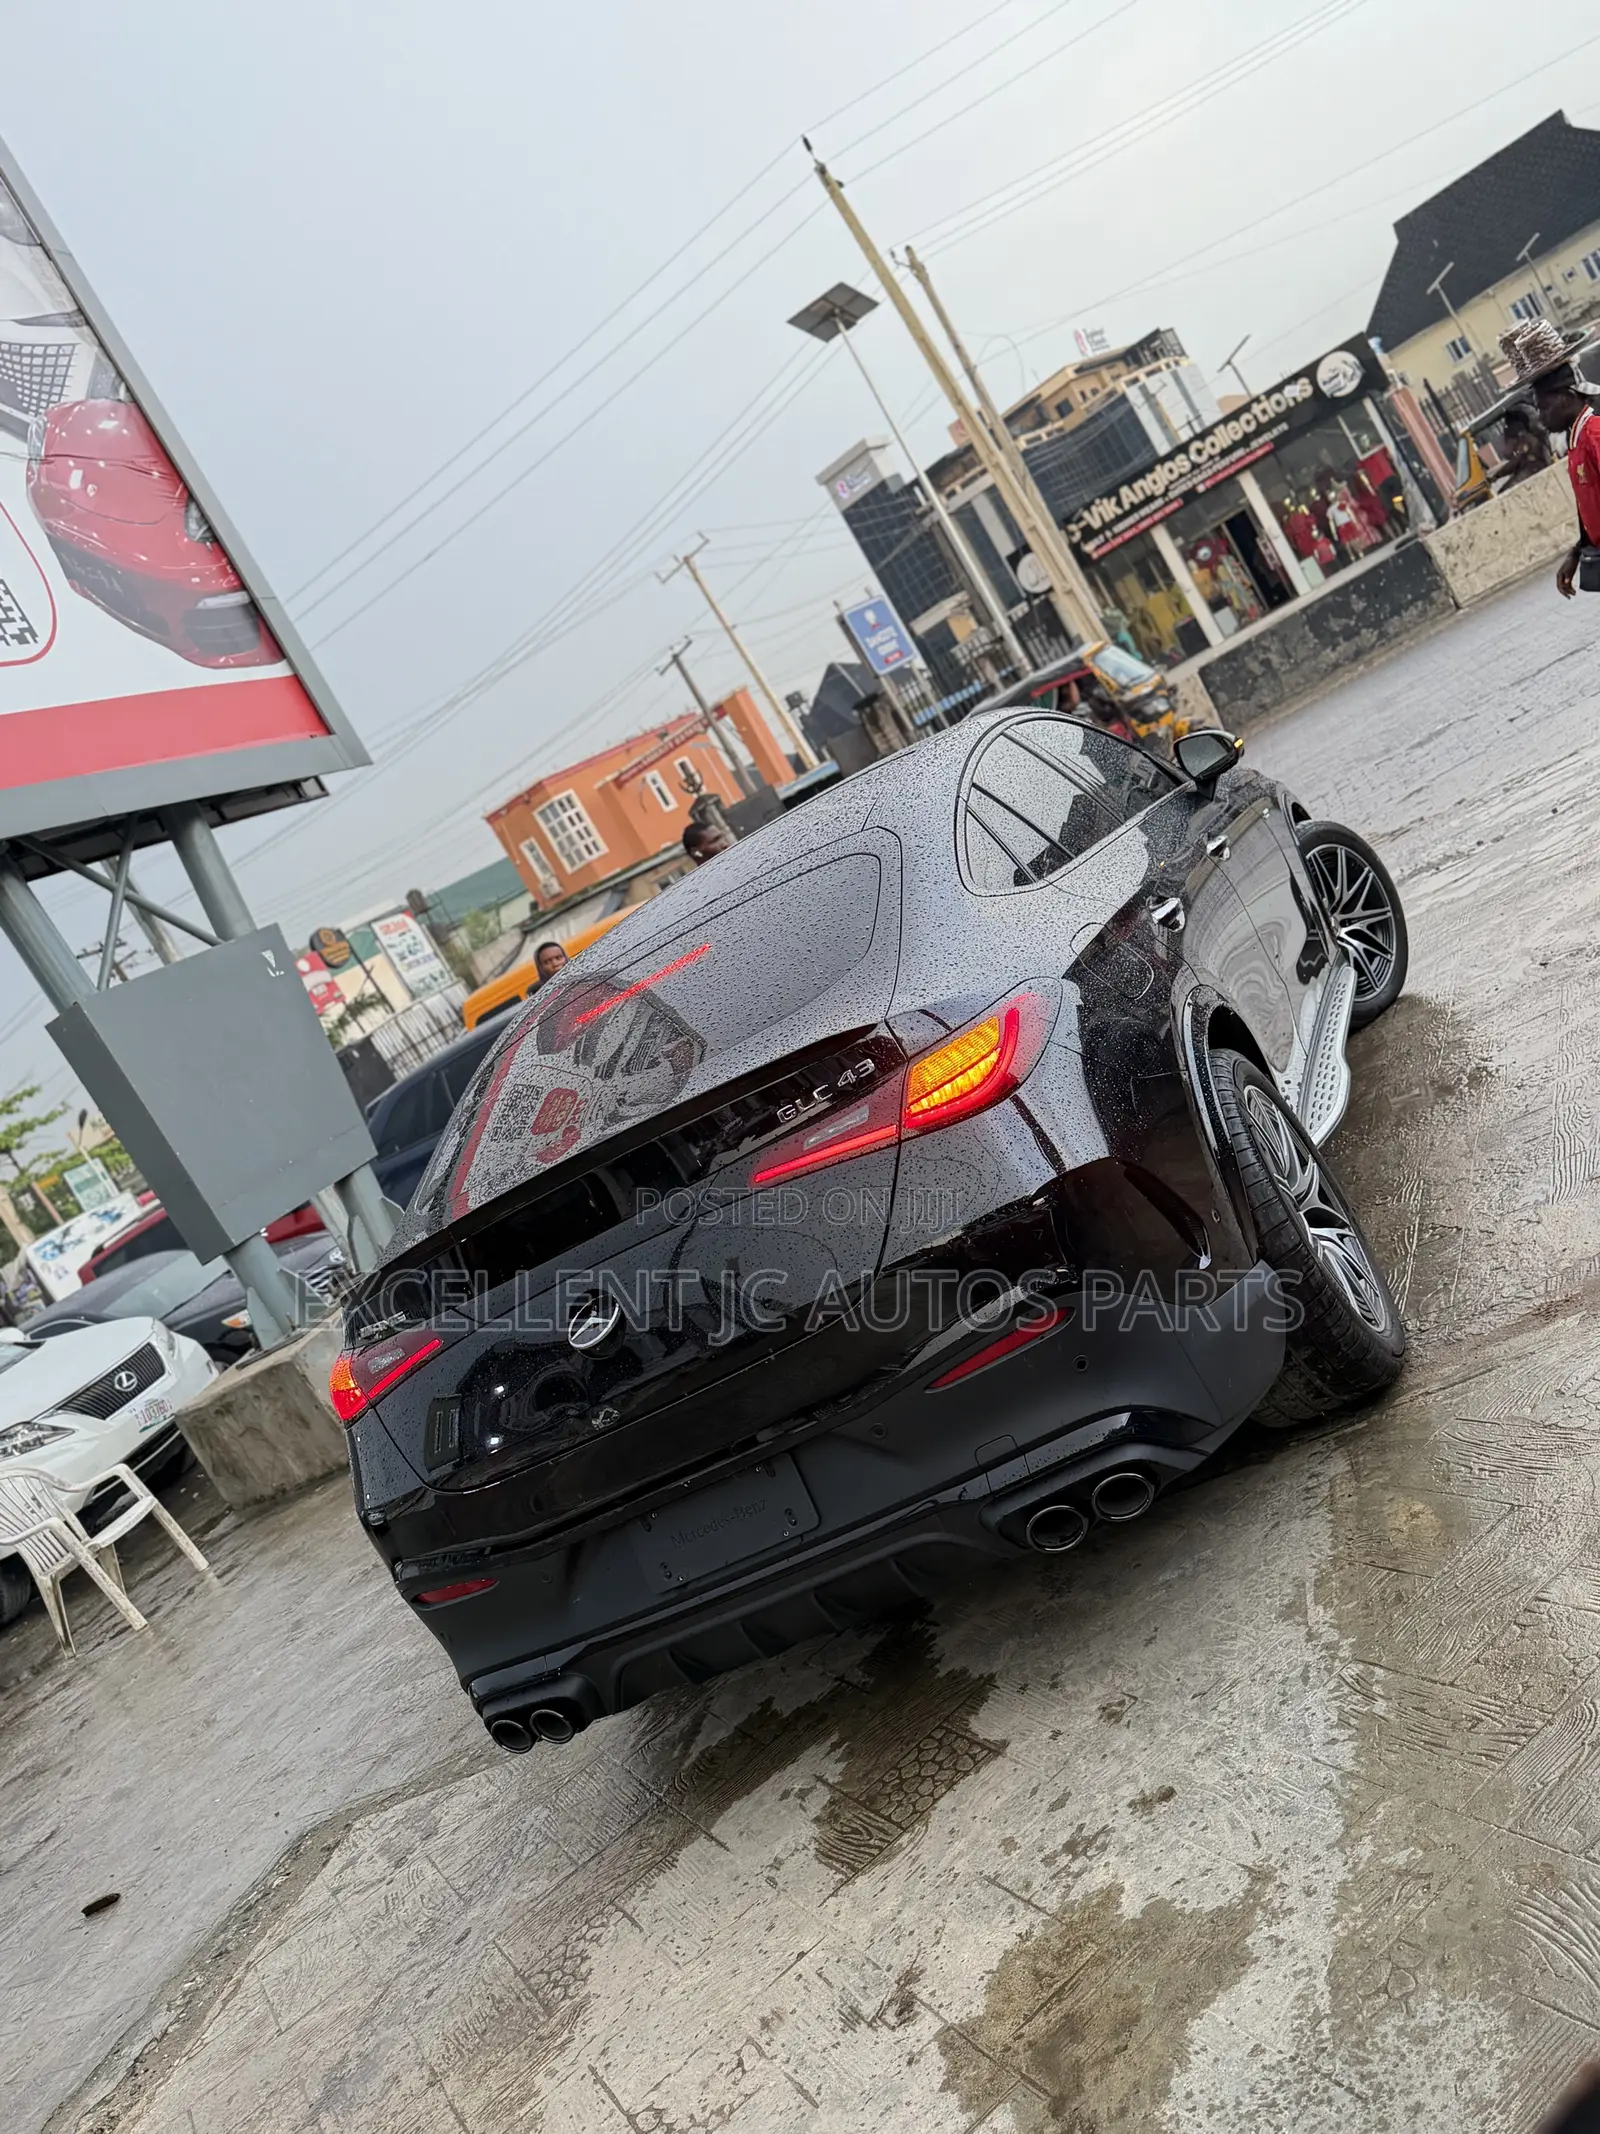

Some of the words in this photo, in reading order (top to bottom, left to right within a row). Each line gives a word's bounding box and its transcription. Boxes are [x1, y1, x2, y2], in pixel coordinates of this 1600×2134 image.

[1119, 453, 1192, 510] Anglos
[777, 1084, 834, 1123] GLC
[837, 1058, 876, 1088] 43
[670, 1499, 767, 1550] Mercedes-Benz
